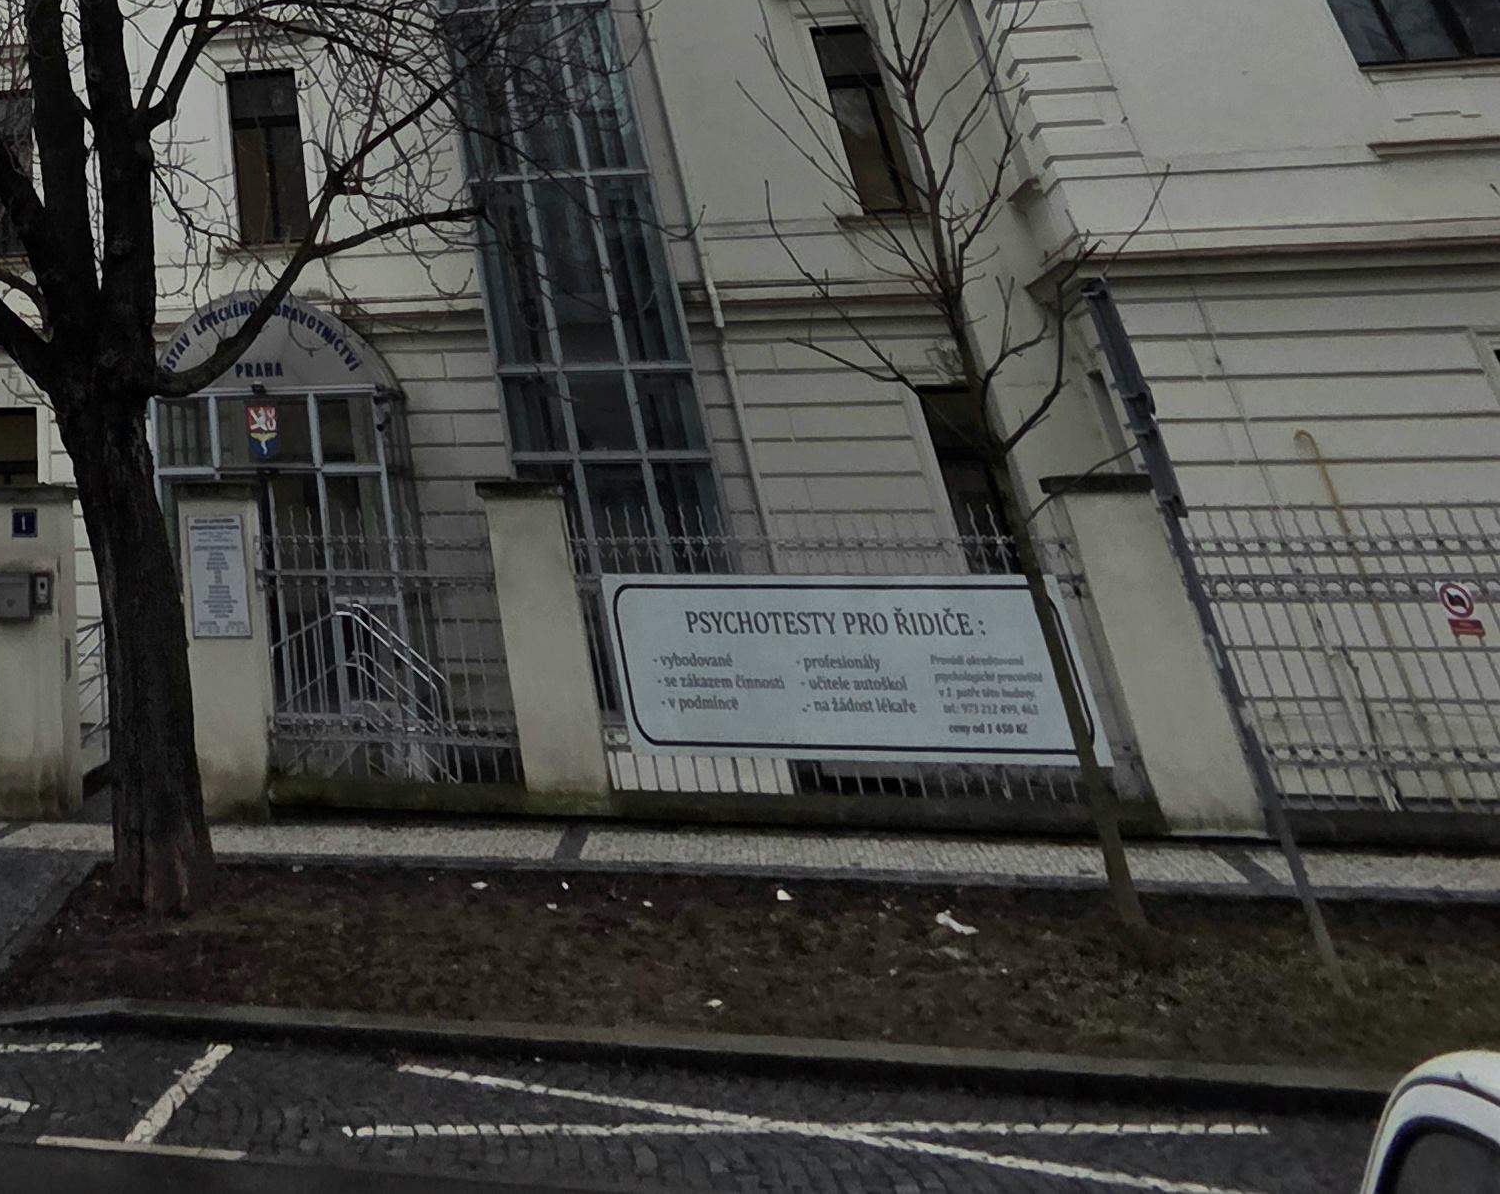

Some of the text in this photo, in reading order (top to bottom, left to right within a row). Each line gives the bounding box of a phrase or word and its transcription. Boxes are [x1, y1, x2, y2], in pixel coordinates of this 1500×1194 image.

[192, 300, 258, 336] LETECKÉHO
[235, 362, 283, 378] PRAHA
[685, 611, 835, 635] PSYCHOTESTY
[842, 612, 888, 636] PRO
[893, 607, 974, 636] ŘIDIČE
[660, 652, 733, 669] vybodované
[803, 654, 881, 673] profesionály
[664, 674, 786, 690] se zákazem činnosti
[808, 676, 908, 692] učitele autoškol
[668, 695, 739, 713] v podmínce
[813, 697, 918, 714] na žádost lékaře
[949, 724, 970, 736] ceny
[972, 723, 985, 734] od
